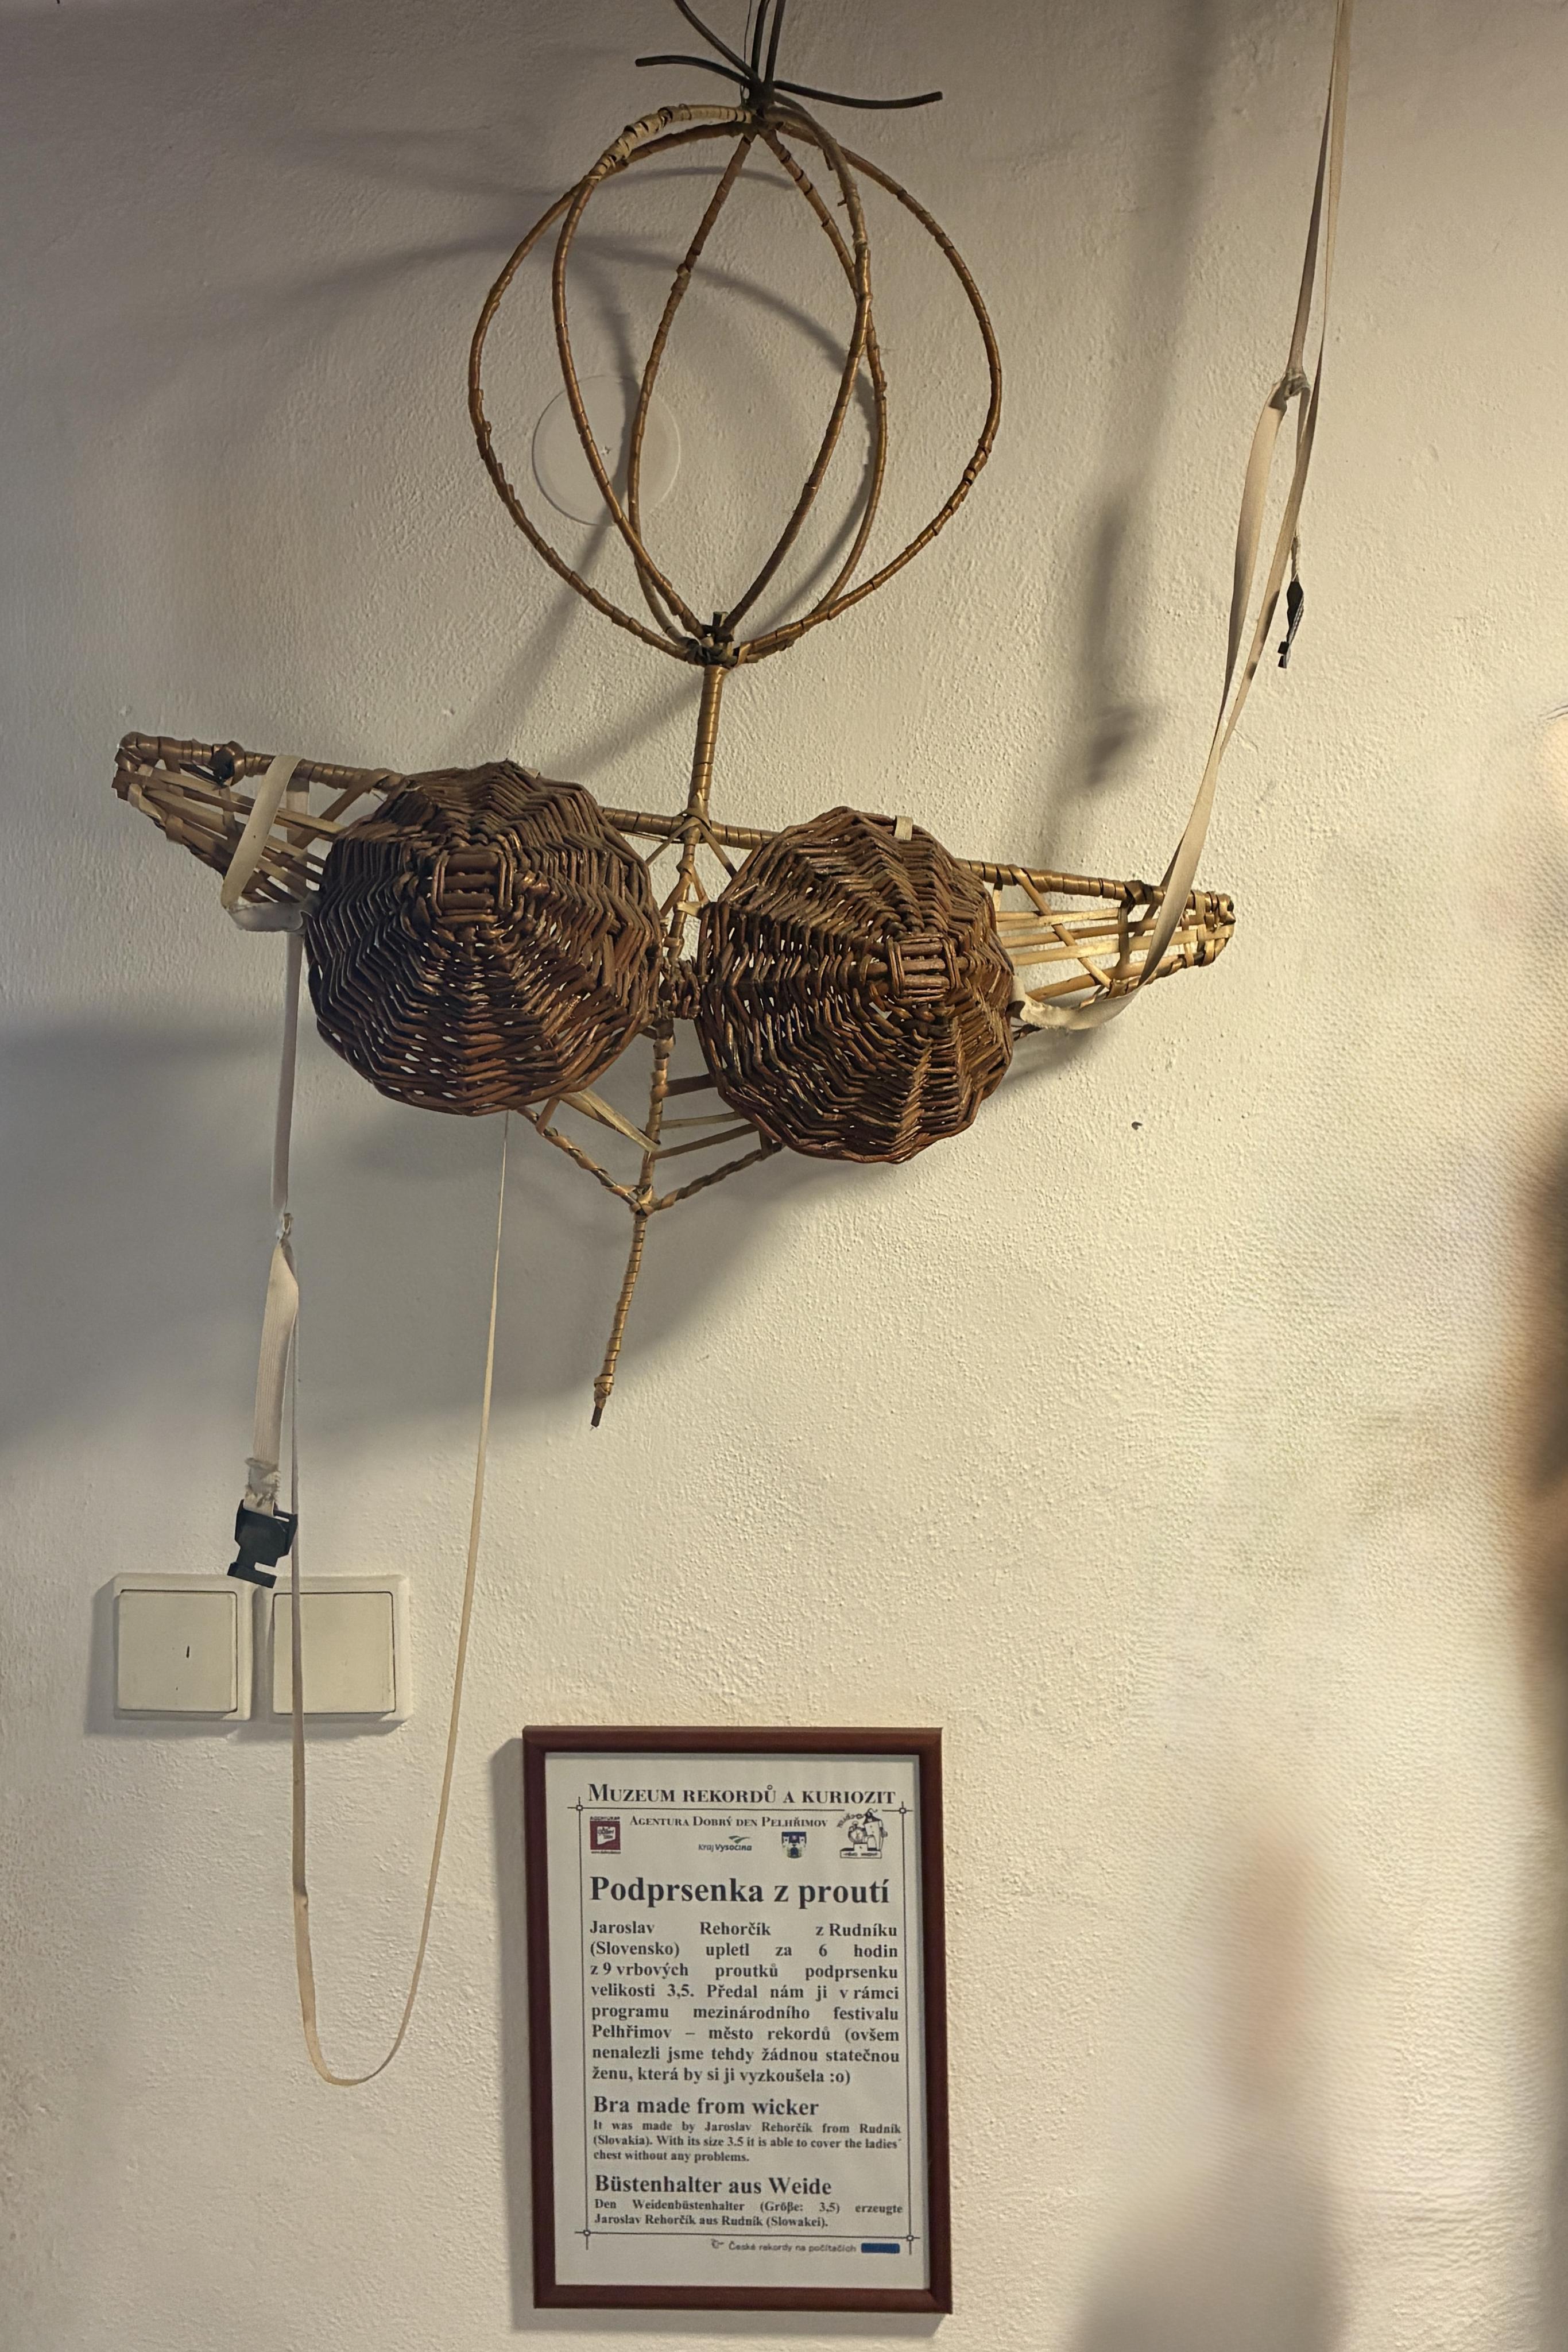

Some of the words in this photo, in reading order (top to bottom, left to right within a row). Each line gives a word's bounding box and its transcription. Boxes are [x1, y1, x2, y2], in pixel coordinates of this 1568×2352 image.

[590, 1877, 764, 1908] Podprsenka
[774, 1886, 788, 1902] z
[799, 1879, 889, 1909] proutí
[590, 1921, 654, 1933] Jaroslav
[700, 1922, 771, 1935] Rehorčík
[816, 1927, 823, 1936] z
[830, 1923, 897, 1936] Rudníku
[590, 1941, 679, 1958] (Slovensko)
[706, 1943, 749, 1959] upletl
[776, 1947, 792, 1956] za
[819, 1944, 827, 1956] 6
[854, 1944, 897, 1958] hodin
[591, 1966, 598, 1975] z
[603, 1962, 611, 1975] 9
[617, 1962, 688, 1979] vrbových
[715, 1964, 777, 1980] proutků
[806, 1965, 897, 1982] podprsenku
[591, 1983, 655, 1997] velikosti
[667, 1984, 694, 1998] 3,5.
[707, 1984, 757, 1998] Předal
[771, 1984, 803, 1998] nám
[815, 1985, 827, 2002] ji
[839, 1990, 848, 1998] v
[854, 1986, 899, 1999] rámci
[592, 2007, 668, 2021] programu
[694, 2006, 810, 2019] mezinárodního
[834, 2006, 898, 2020] festivalu
[593, 2024, 671, 2038] Pelhřimov
[709, 2026, 753, 2040] město
[768, 2026, 830, 2040] rekordů
[845, 2028, 899, 2043] (ovšem
[593, 2046, 660, 2059] nenalezli
[667, 2047, 703, 2063] jsme
[712, 2047, 753, 2064] tehdy
[762, 2048, 818, 2061] žádnou
[826, 2049, 899, 2062] statečnou
[592, 2066, 633, 2082] ženu,
[638, 2067, 678, 2080] která
[684, 2067, 702, 2084] by
[707, 2067, 719, 2080] si
[723, 2068, 734, 2084] ji
[740, 2069, 824, 2085] vyzkoušela
[594, 2096, 629, 2113] Bra
[637, 2097, 690, 2114] made
[697, 2098, 745, 2114] from
[752, 2098, 819, 2115] wicker
[594, 2119, 602, 2129] It
[642, 2121, 672, 2130] made
[682, 2121, 694, 2134] by
[704, 2121, 751, 2132] Jaroslav
[762, 2122, 812, 2133] Rehorčík
[822, 2123, 849, 2133] from
[860, 2123, 901, 2134] Rudník
[593, 2135, 653, 2146] (Slovakia).
[656, 2136, 684, 2145] With
[688, 2136, 700, 2146] its
[703, 2137, 724, 2146] size
[747, 2137, 754, 2146] it
[758, 2137, 766, 2146] is
[771, 2137, 793, 2146] able
[797, 2139, 807, 2147] to
[811, 2140, 841, 2148] cover
[845, 2138, 862, 2148] the
[594, 2149, 621, 2160] chest
[625, 2150, 667, 2160] without
[671, 2153, 691, 2163] any
[694, 2152, 749, 2164] problems.
[596, 2175, 722, 2193] Büstenhalter
[729, 2182, 761, 2194] aus
[769, 2177, 831, 2195] Weide
[595, 2199, 616, 2208] Den
[855, 2205, 903, 2215] erzeugte
[594, 2214, 640, 2224] Jaroslav
[645, 2214, 696, 2225] Rehorčík
[722, 2215, 763, 2226] Rudník
[766, 2216, 828, 2229] (Slowakei).
